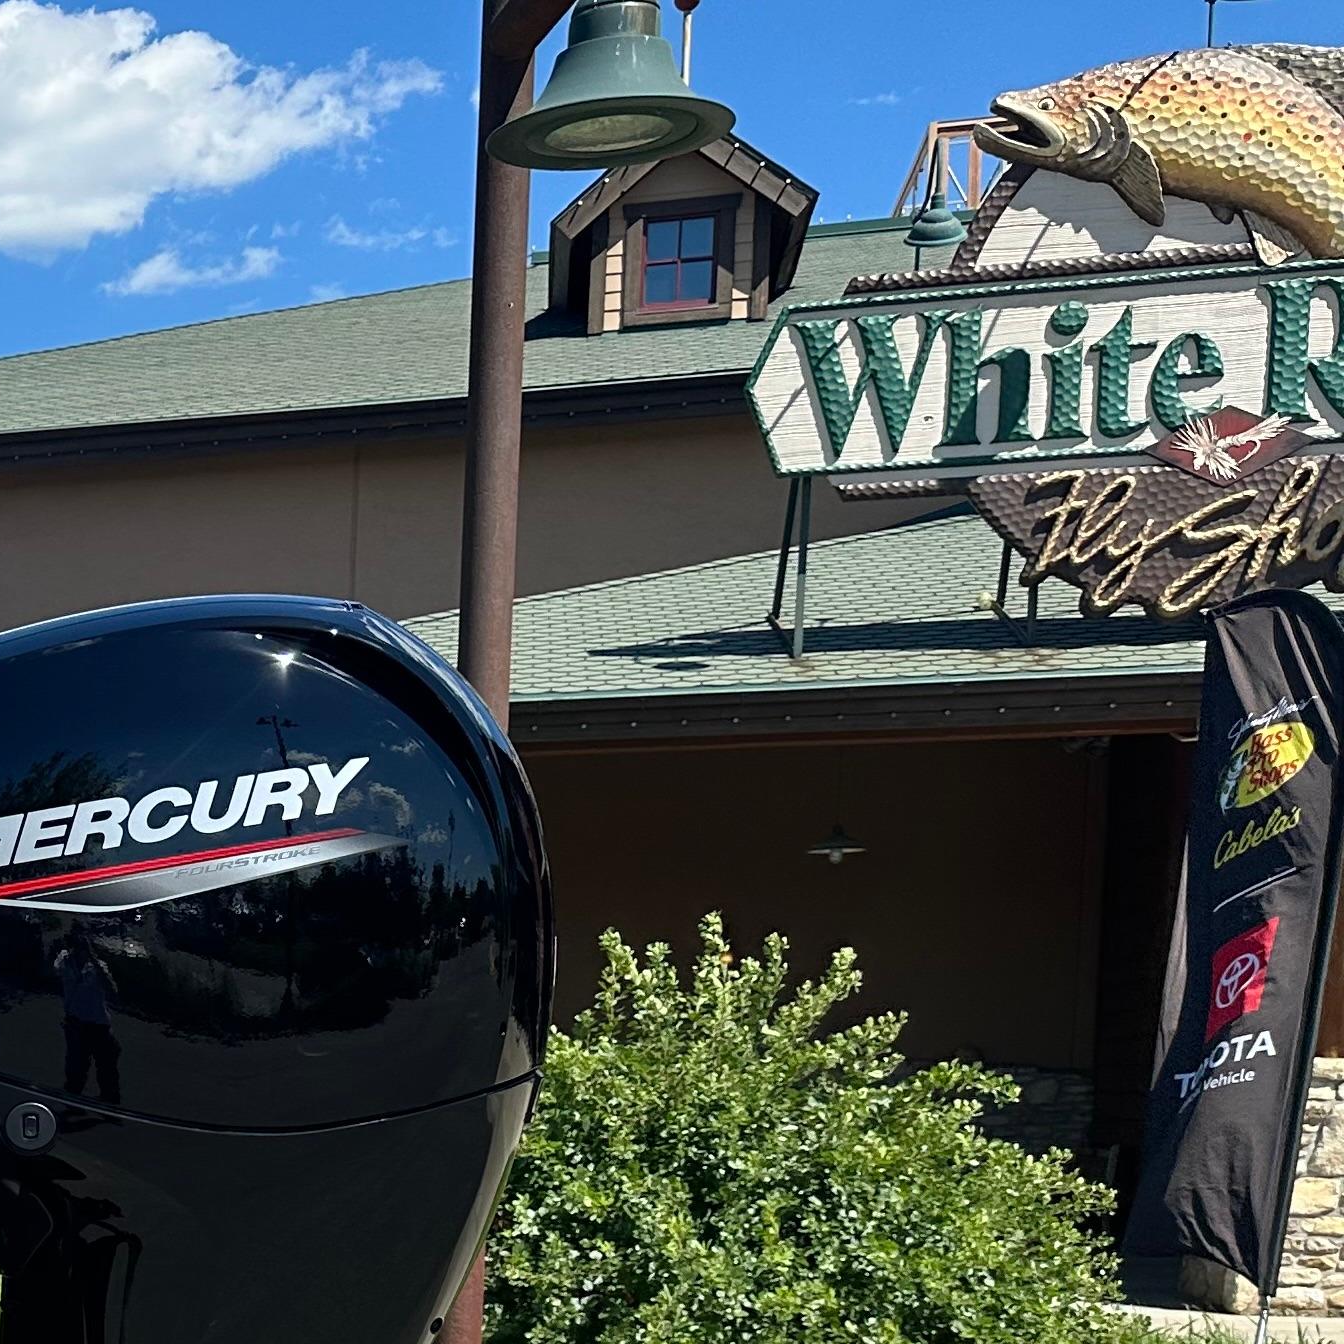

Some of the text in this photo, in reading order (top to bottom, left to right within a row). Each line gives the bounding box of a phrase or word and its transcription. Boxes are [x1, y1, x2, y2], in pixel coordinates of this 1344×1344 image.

[789, 300, 1225, 463] White
[1029, 460, 1344, 614] Fly Sho
[1251, 726, 1293, 751] Bass
[1247, 759, 1300, 794] Shops
[1214, 805, 1302, 869] Cabela's
[174, 845, 321, 879] FOURSTROKE
